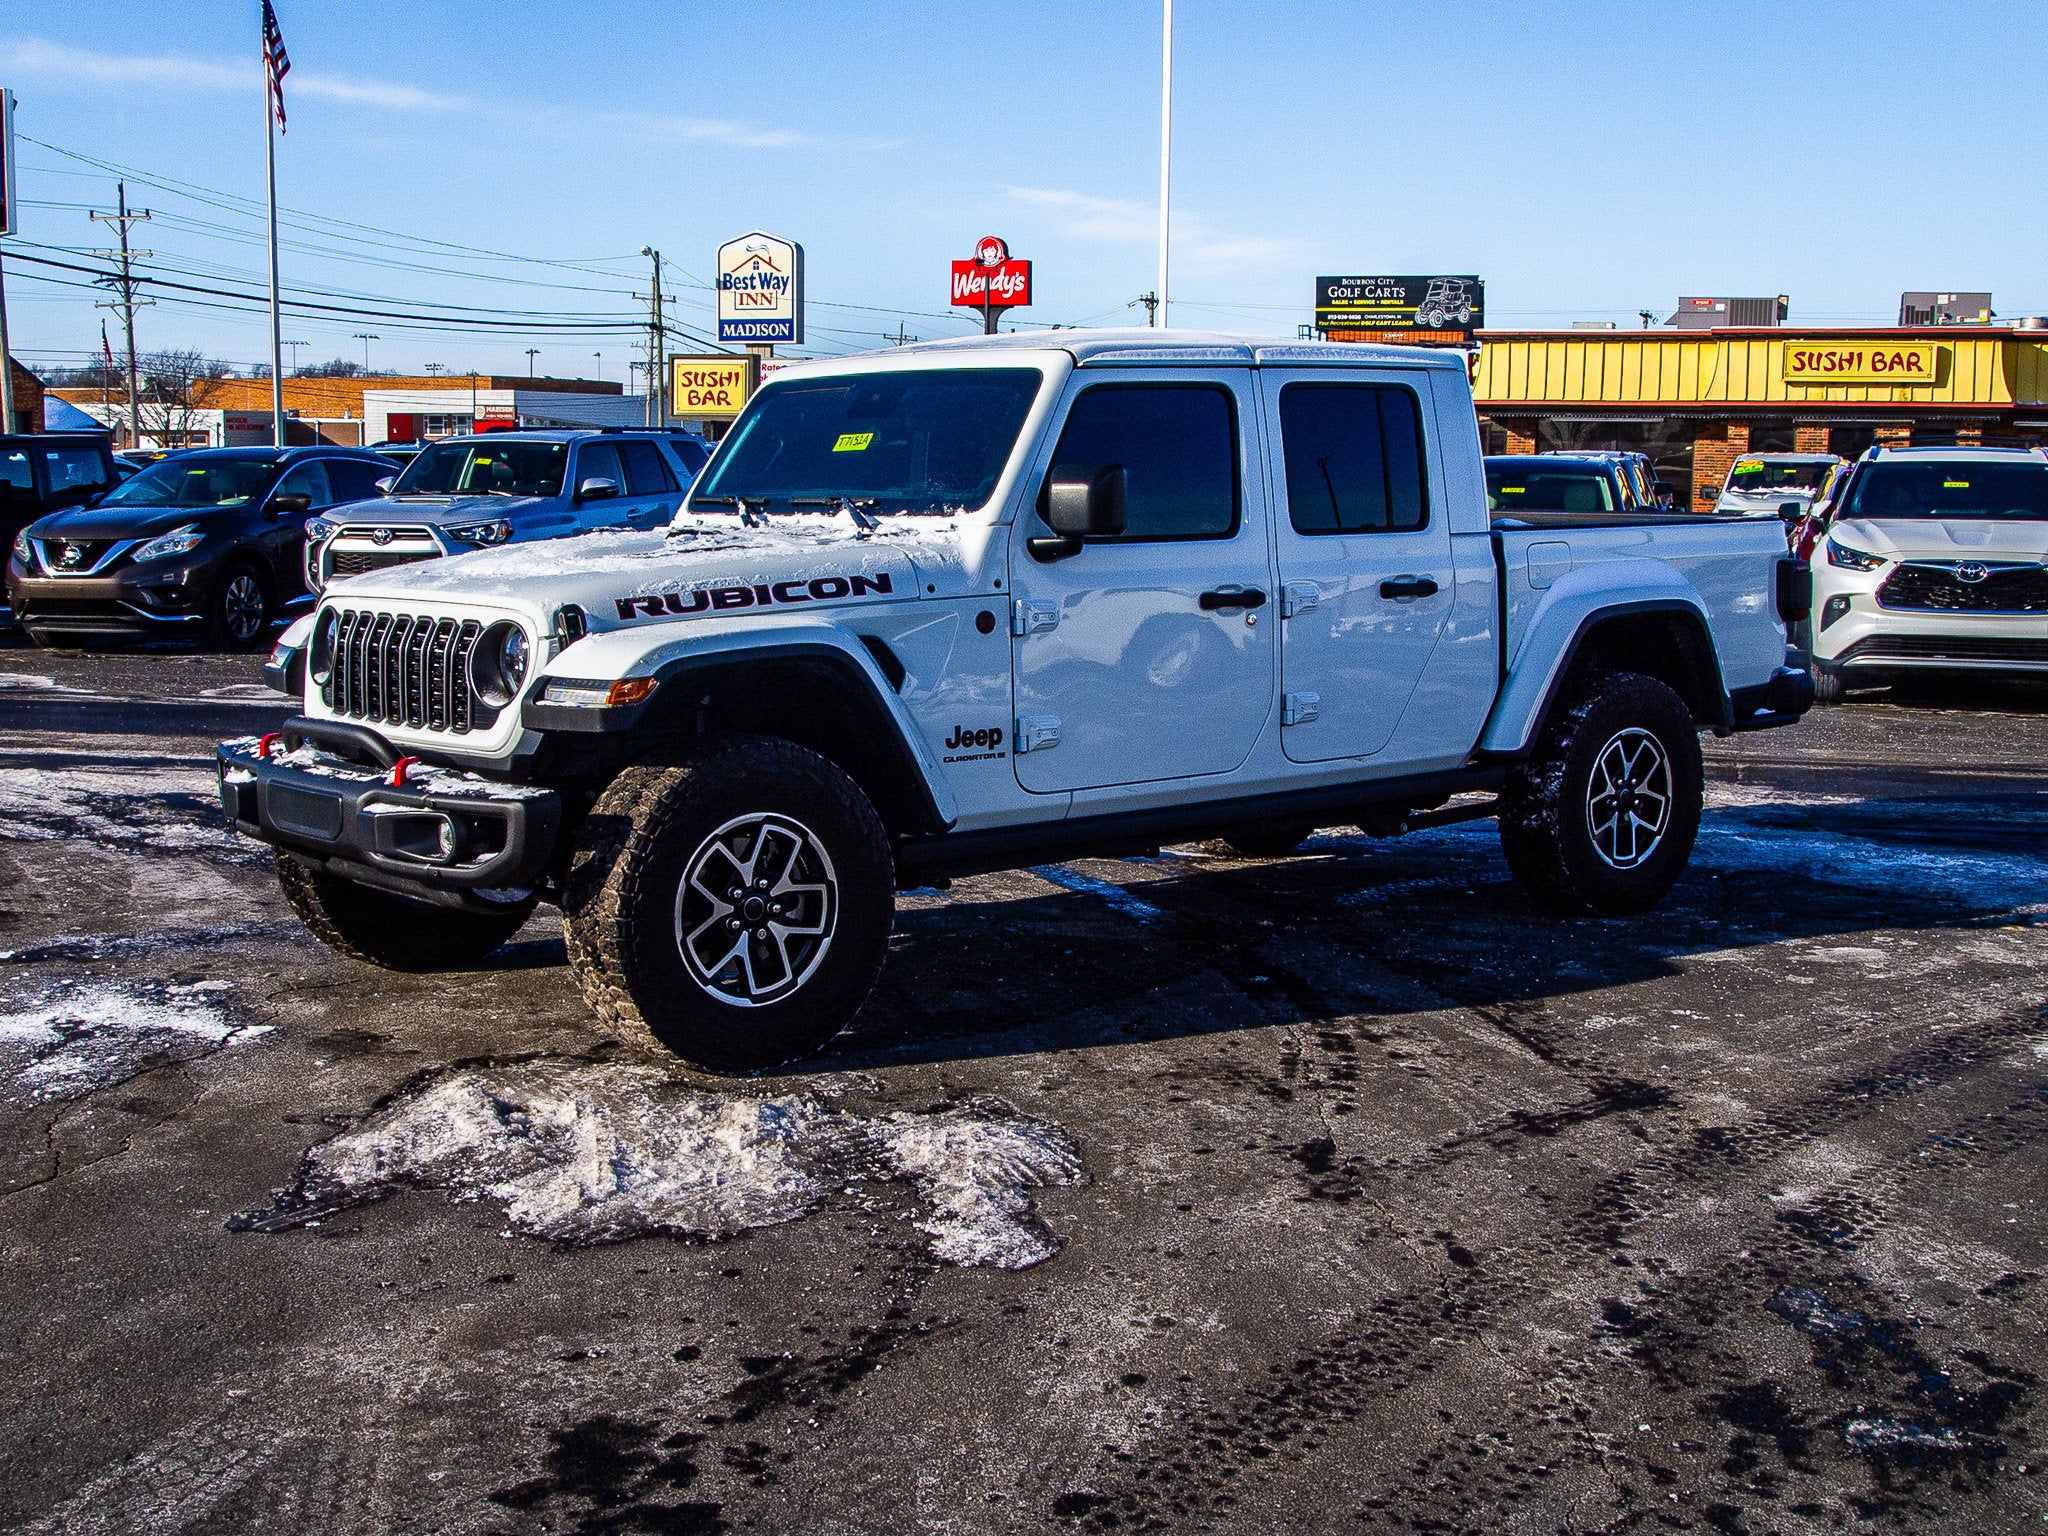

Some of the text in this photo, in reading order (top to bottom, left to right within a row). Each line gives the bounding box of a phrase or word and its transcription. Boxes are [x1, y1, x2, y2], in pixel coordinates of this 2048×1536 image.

[723, 272, 789, 295] Best Way
[953, 266, 1025, 299] Wendy's
[1377, 277, 1395, 285] CITY
[738, 292, 773, 306] INN
[1328, 286, 1405, 298] GOLF CARTS
[722, 323, 790, 337] MADISON
[1792, 351, 1924, 372] SUSHI BAR
[681, 371, 740, 388] SUSHI
[687, 389, 732, 406] BAR
[614, 572, 894, 621] RUBICON
[945, 725, 1003, 750] Jeep
[943, 752, 997, 763] GLADIATOR
